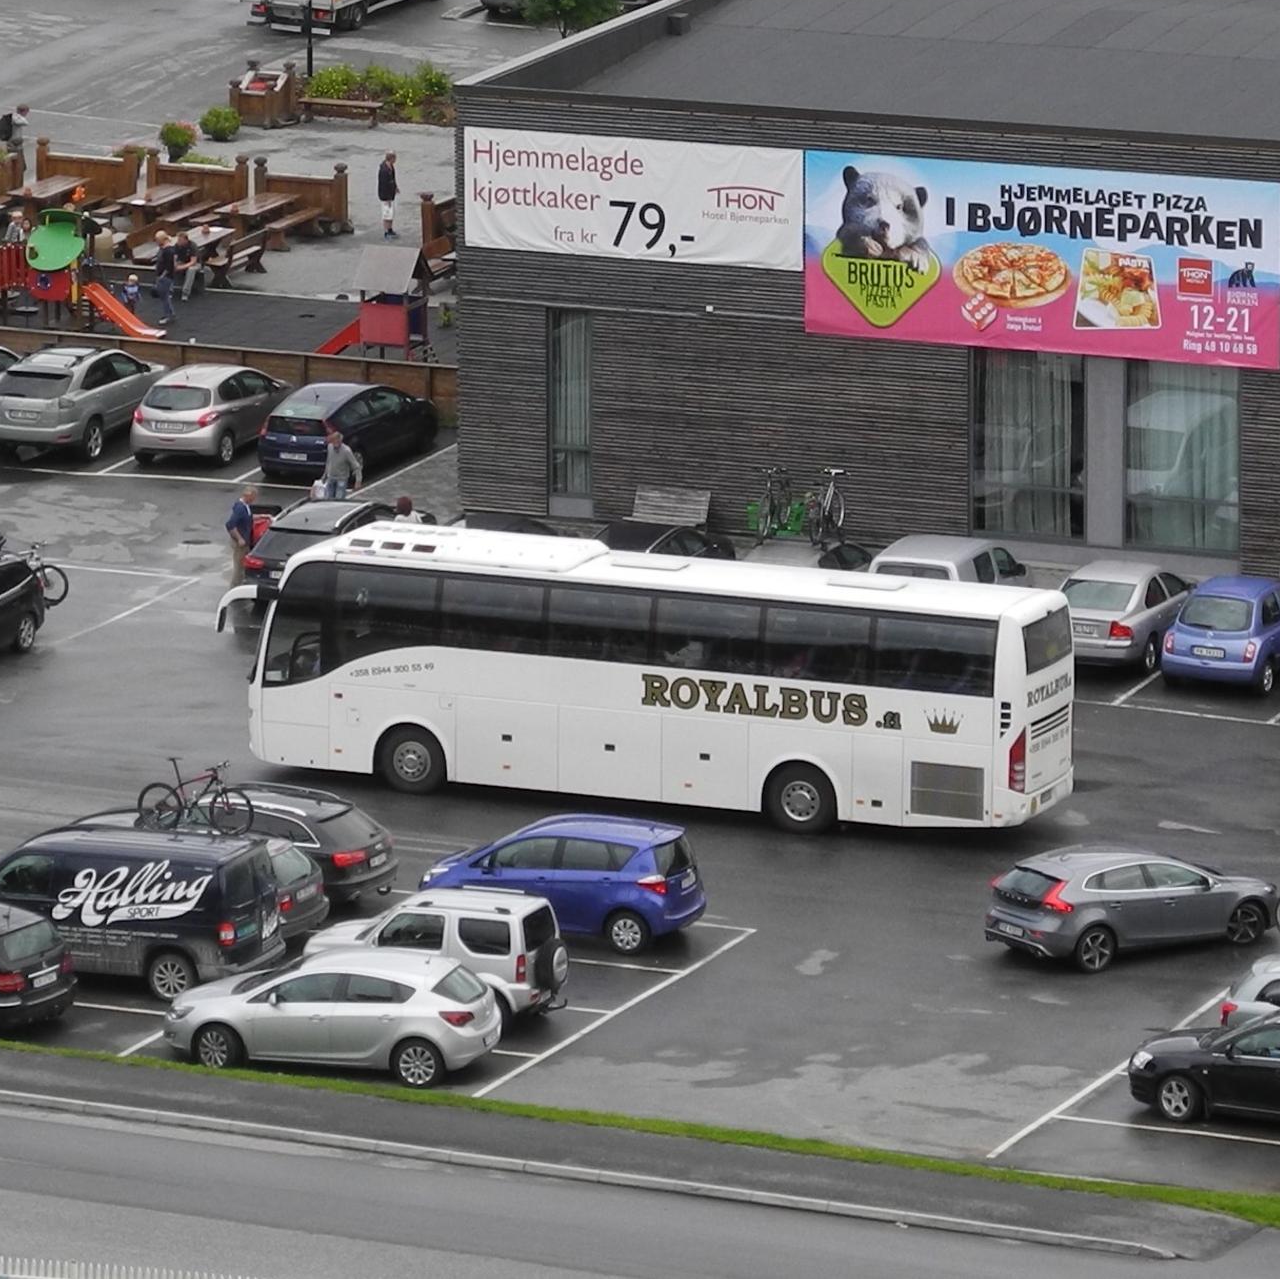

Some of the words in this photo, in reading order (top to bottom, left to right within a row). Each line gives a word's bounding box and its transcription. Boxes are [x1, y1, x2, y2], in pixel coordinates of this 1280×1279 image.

[473, 139, 644, 181] Hjemmelagde
[473, 178, 601, 211] kjøttkaker
[707, 186, 785, 212] THON
[1000, 183, 1147, 209] HJEMMELAGET
[1153, 193, 1208, 213] PIZZA
[702, 210, 728, 221] Hotel
[730, 212, 790, 226] Bjørneparken
[945, 197, 956, 226] I
[967, 200, 1263, 250] BJØRNEPARKEN
[554, 225, 575, 243] fra
[580, 227, 597, 245] kr
[609, 200, 695, 258] 79,-
[1119, 257, 1150, 269] PASTA
[1180, 268, 1212, 279] THON
[848, 261, 915, 289] BRUTUS
[860, 284, 902, 299] PIZZERIA
[1227, 291, 1258, 299] BJØRNE
[1227, 298, 1259, 306] PARKEN
[866, 295, 897, 310] PASTA
[1191, 305, 1250, 333] 12-21
[1183, 339, 1202, 353] Ring
[393, 664, 409, 673] 300
[412, 663, 422, 672] 55
[424, 662, 434, 671] 49
[642, 673, 869, 726] ROYALBUS
[52, 859, 214, 927] Halling
[127, 906, 162, 919] SPORT
